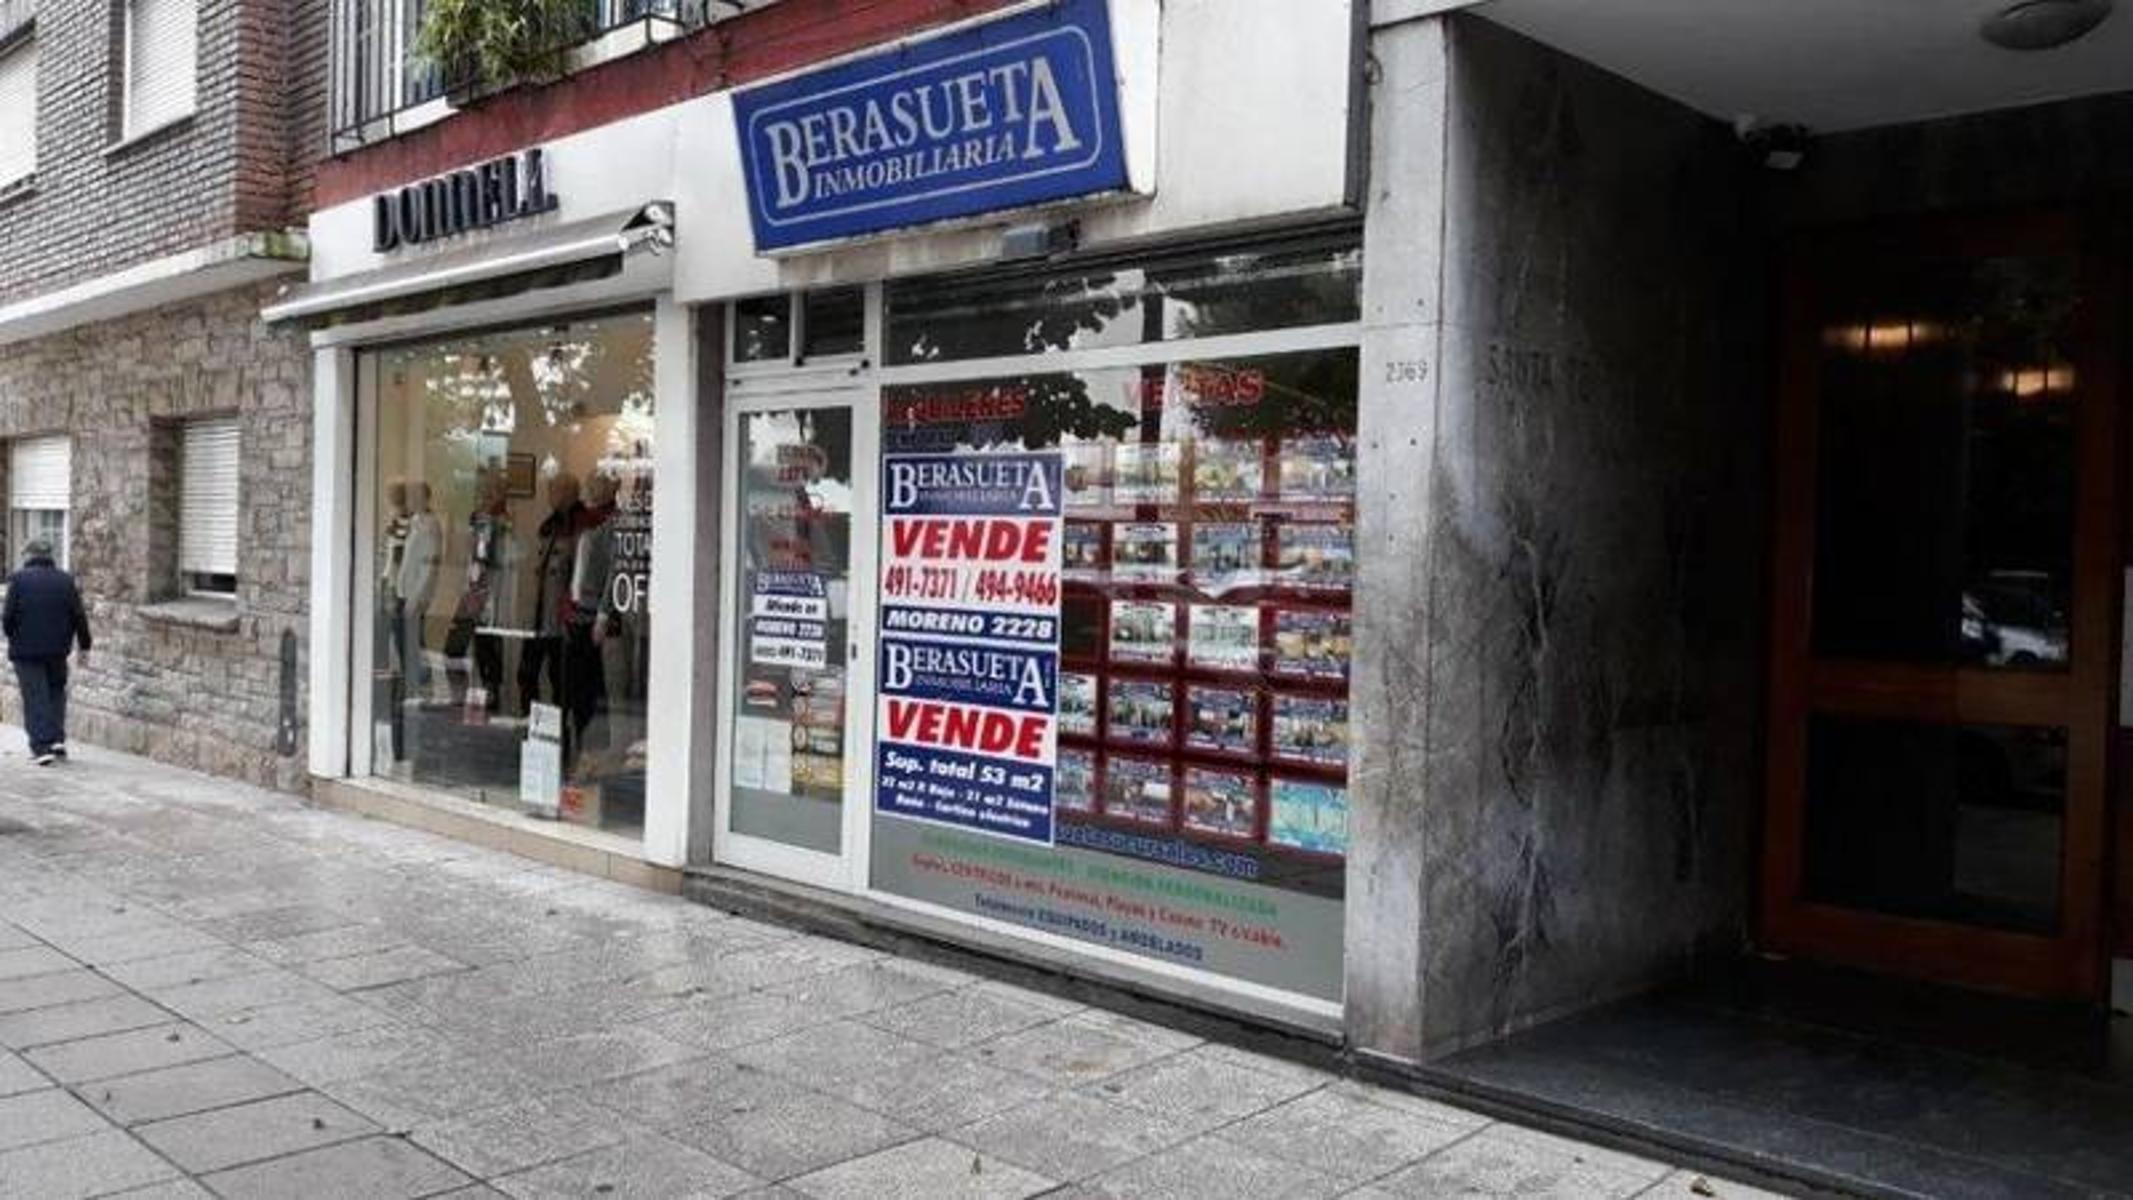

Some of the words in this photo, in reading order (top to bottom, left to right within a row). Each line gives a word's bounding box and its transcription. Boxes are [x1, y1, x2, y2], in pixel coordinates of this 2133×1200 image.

[765, 56, 1083, 208] BERASUETA
[814, 131, 1015, 199] INMOBILIARIA
[889, 461, 1055, 510] BERASUETA
[893, 520, 1053, 562] VENDE
[885, 566, 957, 598] 491-7371
[975, 569, 1057, 606] 494-9466
[886, 610, 984, 633] MORENO
[991, 616, 1055, 639] 2228
[885, 643, 1050, 707] BERASUETA
[888, 700, 1048, 758] VENDE
[885, 751, 924, 774] Sup.
[930, 759, 977, 781] total
[980, 765, 1007, 785] 53
[1010, 773, 1044, 793] m2
